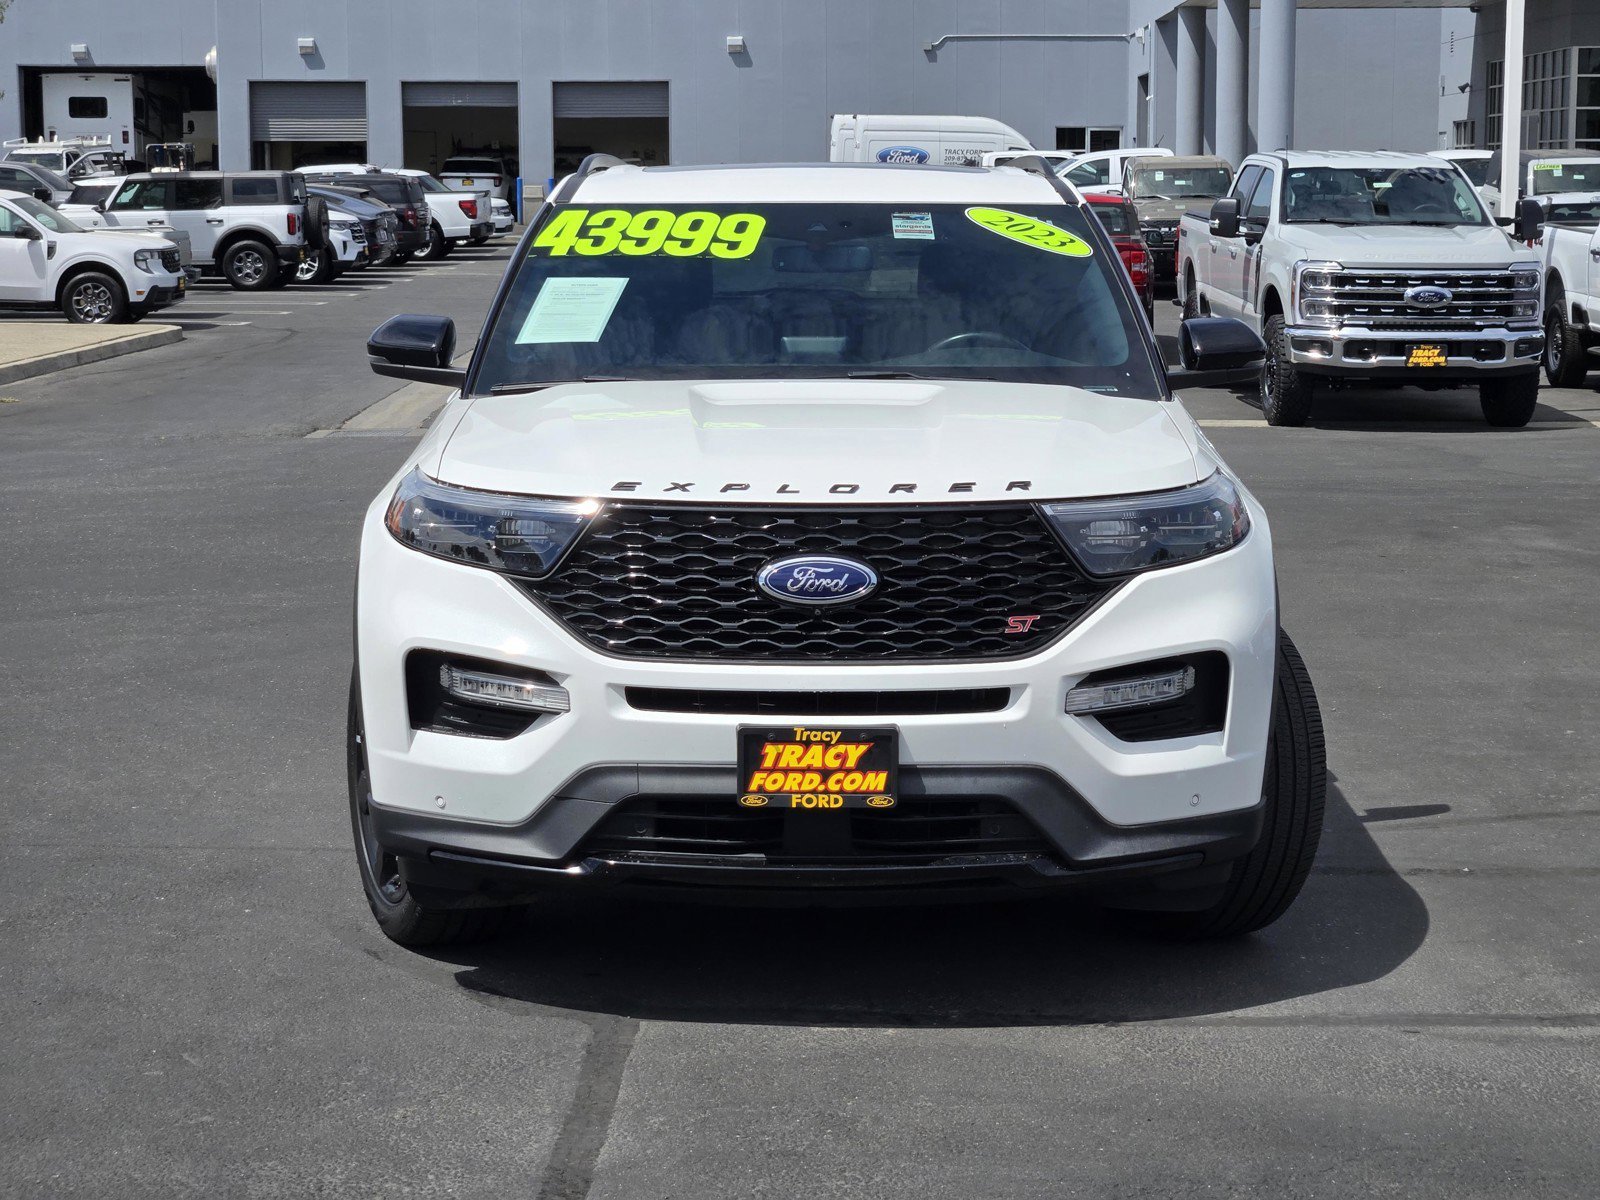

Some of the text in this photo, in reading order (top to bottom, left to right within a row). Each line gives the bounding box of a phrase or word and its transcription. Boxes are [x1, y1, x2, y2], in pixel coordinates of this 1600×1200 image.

[886, 149, 919, 163] Ford
[534, 209, 766, 259] 43999
[983, 215, 1076, 248] 2023
[1418, 292, 1440, 302] Ford
[1411, 348, 1441, 357] TRACY
[611, 481, 1033, 494] EXPLORER
[787, 566, 850, 593] Ford
[1004, 615, 1041, 633] ST
[793, 727, 842, 744] Tracy
[759, 742, 874, 769] TRACY
[748, 771, 888, 792] FORD.COM
[791, 794, 843, 808] FORD
